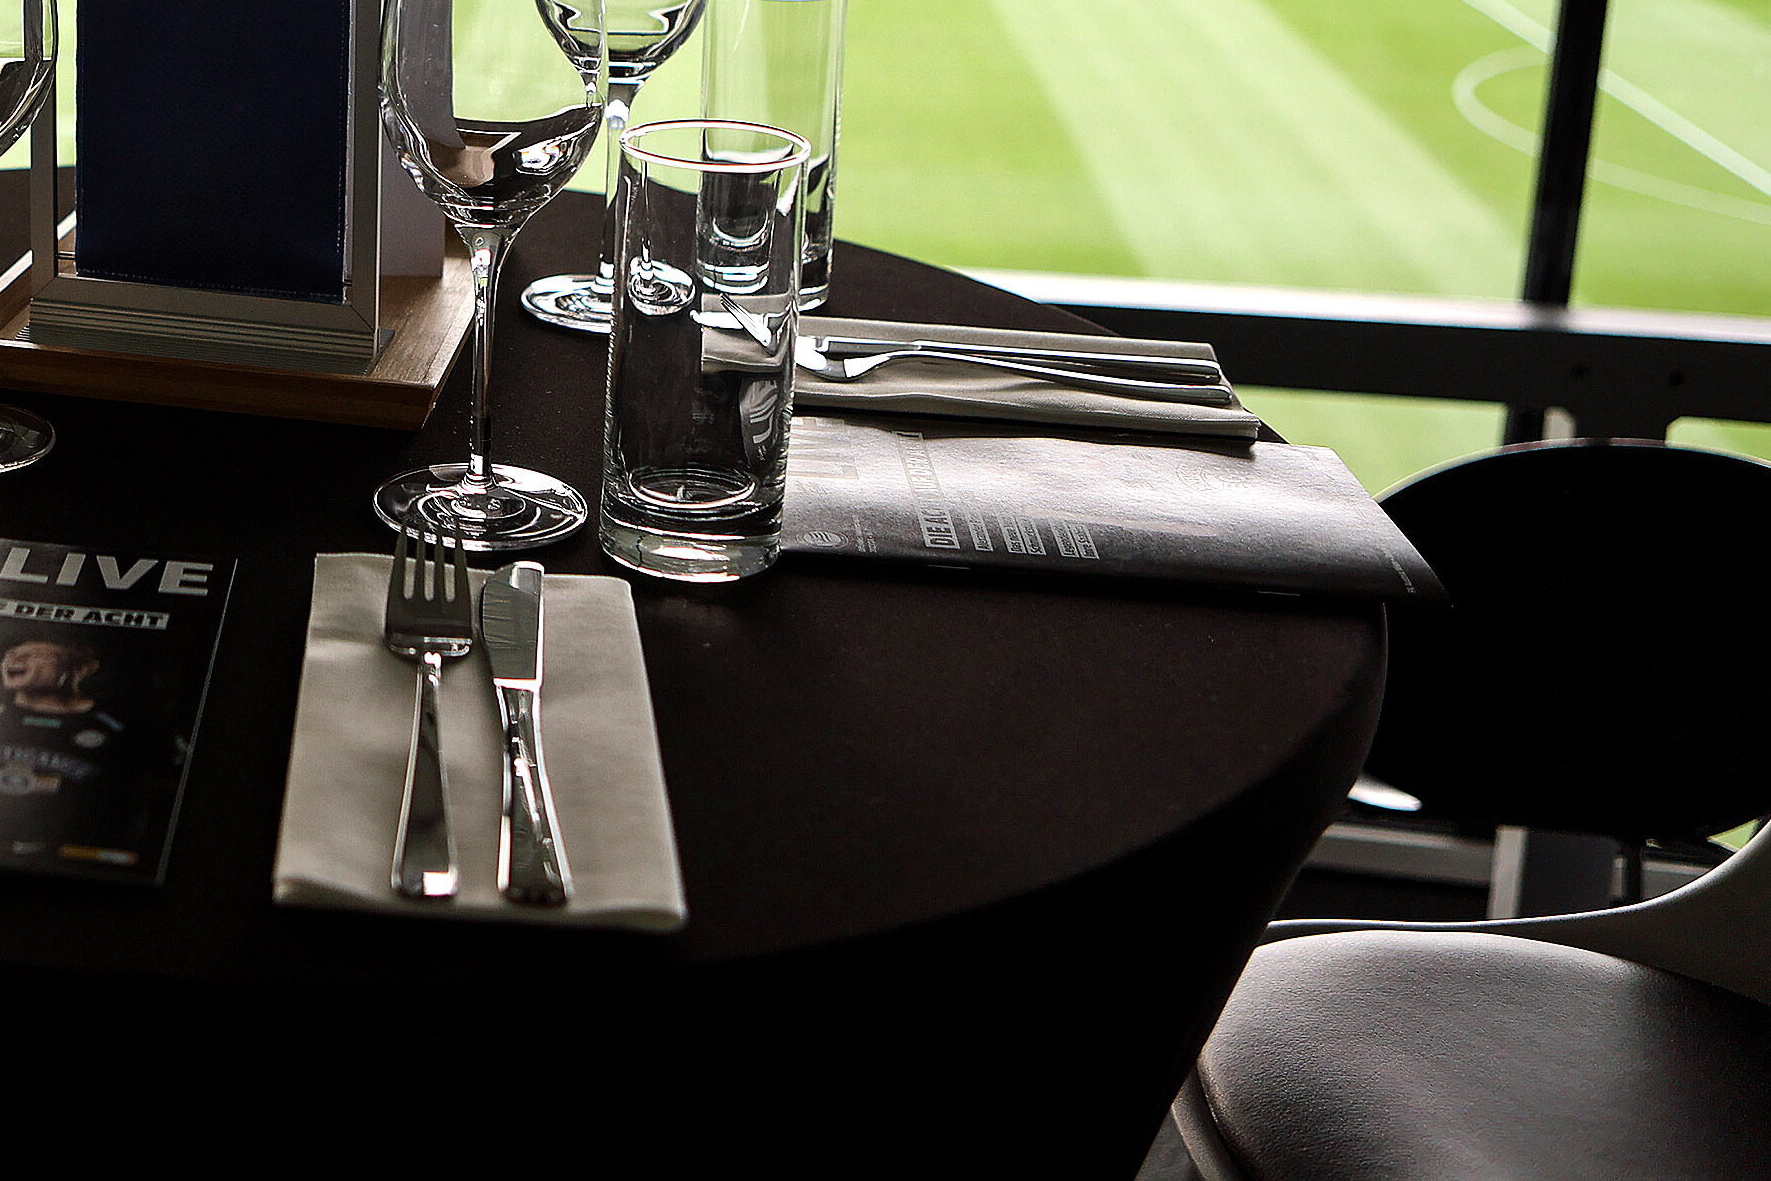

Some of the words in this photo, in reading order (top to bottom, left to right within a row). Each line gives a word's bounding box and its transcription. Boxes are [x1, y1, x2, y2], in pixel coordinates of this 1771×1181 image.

[927, 525, 956, 547] DIE
[14, 601, 75, 621] DER
[83, 611, 166, 628] ACHT
